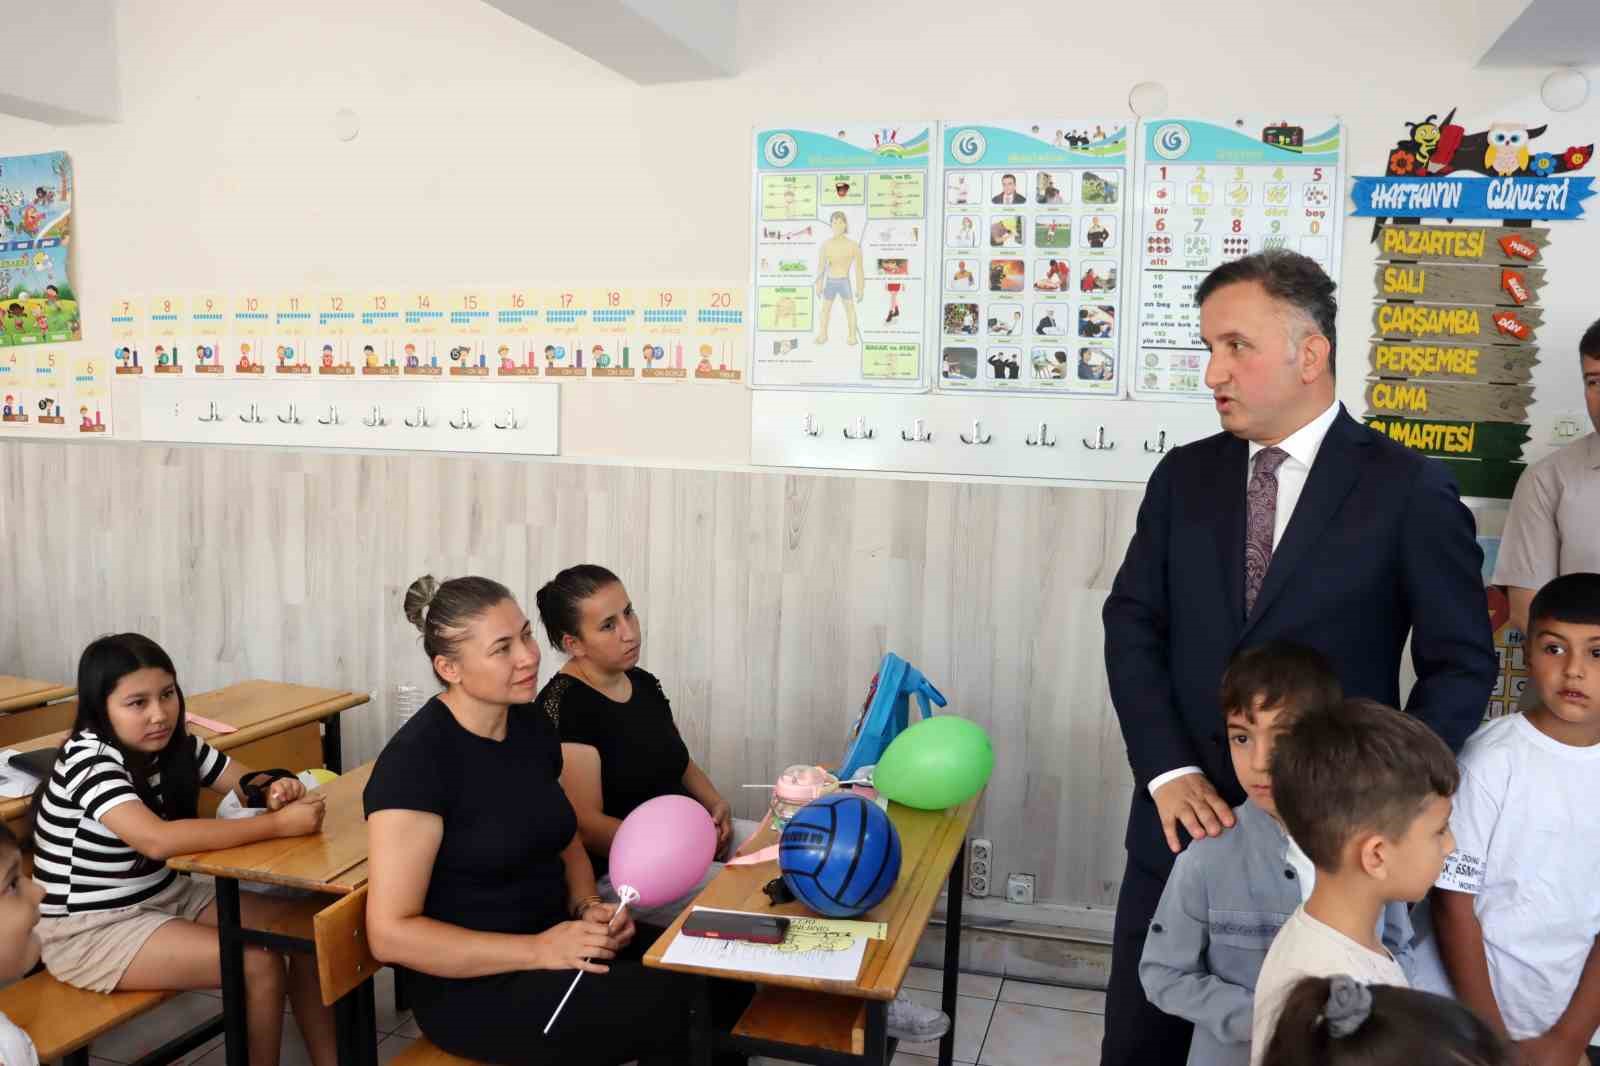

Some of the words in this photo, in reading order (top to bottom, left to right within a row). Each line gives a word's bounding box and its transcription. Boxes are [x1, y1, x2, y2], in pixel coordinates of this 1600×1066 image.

[1159, 166, 1168, 180] 1
[1196, 166, 1206, 181] 2
[1312, 168, 1323, 181] 5
[1487, 177, 1571, 211] GÜNLERİ
[1154, 207, 1168, 215] bir
[1155, 219, 1166, 231] 6
[1193, 219, 1204, 232] 7
[1232, 219, 1242, 232] 8
[1270, 220, 1281, 233] 9
[1311, 221, 1320, 234] 0
[1384, 228, 1486, 257] PAZARTESİ
[1384, 266, 1425, 294] SALI
[206, 299, 214, 313] 9
[246, 298, 258, 312] 10
[290, 298, 299, 312] 11
[331, 297, 344, 312] 12
[375, 296, 387, 311] 13
[418, 295, 431, 309] 14
[463, 295, 478, 310] 15
[512, 293, 526, 308] 16
[560, 293, 574, 308] 17
[608, 292, 621, 307] 18
[659, 293, 674, 307] 19
[711, 293, 732, 308] 20
[122, 302, 129, 315] 7
[164, 301, 171, 314] 8
[1378, 305, 1480, 337] ÇARŞAMBA
[10, 354, 17, 366] 4
[48, 354, 55, 367] 5
[1376, 346, 1479, 376] PERŞEMBE
[86, 361, 94, 374] 6
[1372, 383, 1429, 411] CUMA
